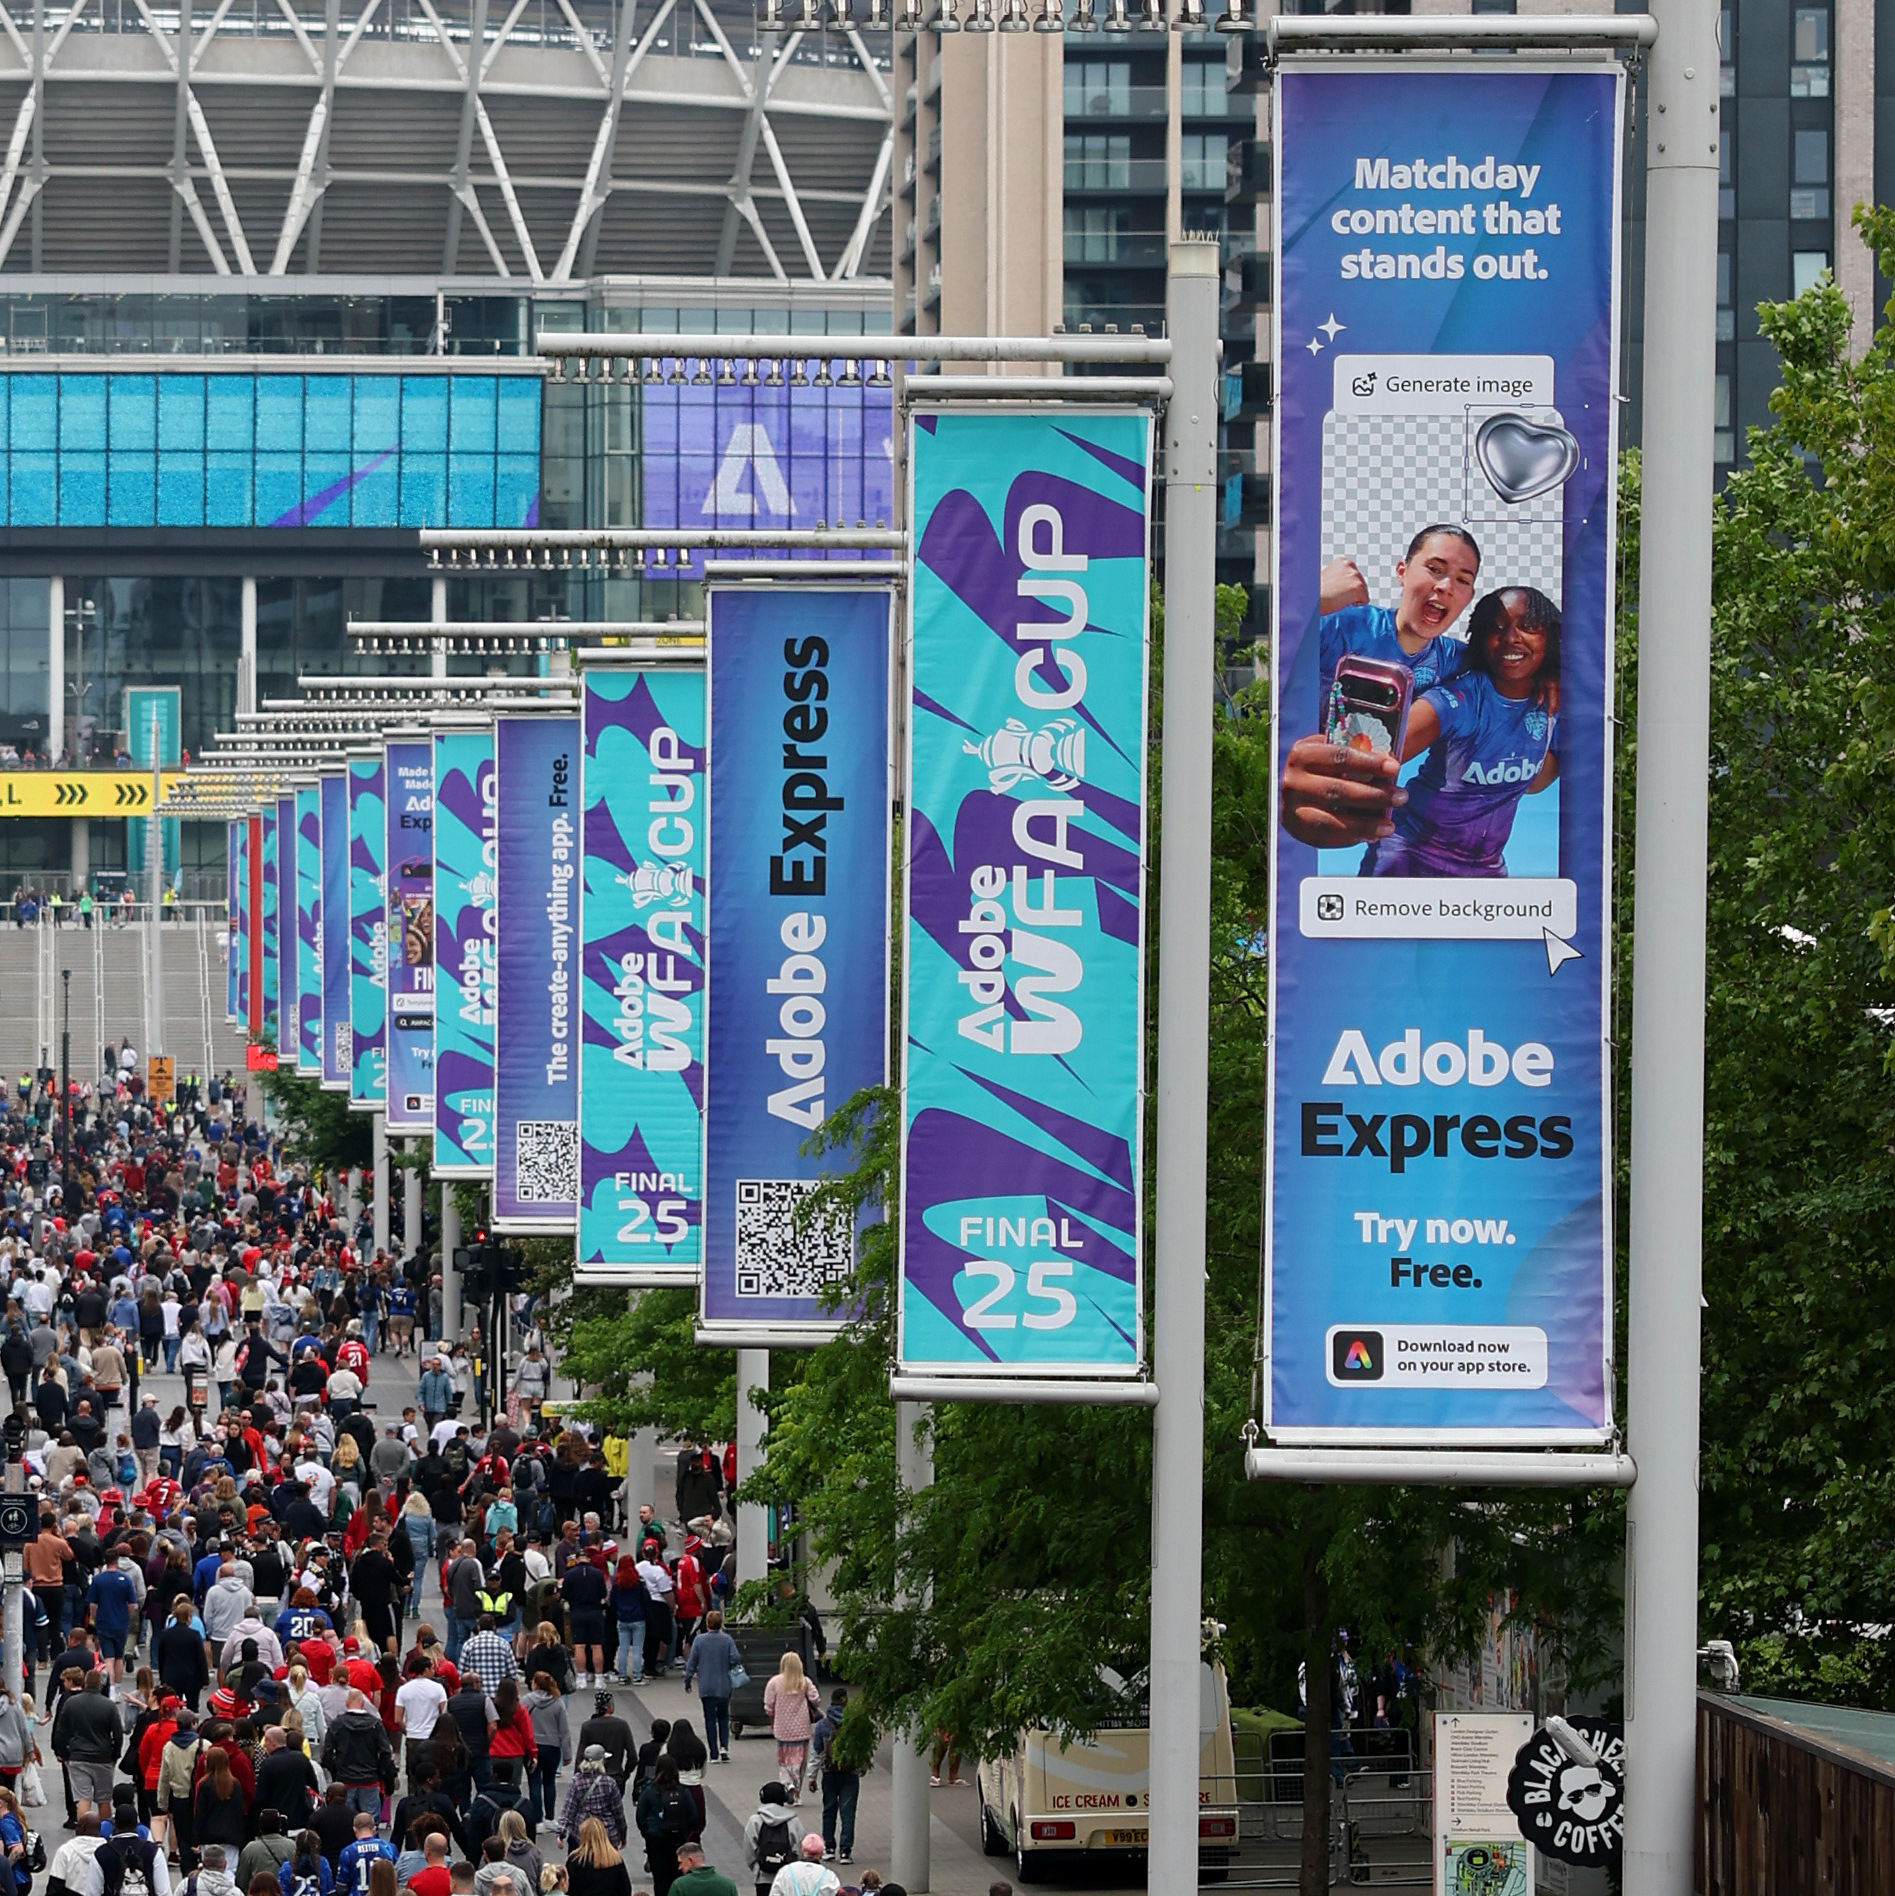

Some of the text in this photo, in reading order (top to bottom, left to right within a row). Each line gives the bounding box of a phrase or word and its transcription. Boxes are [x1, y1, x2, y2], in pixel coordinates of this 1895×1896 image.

[1354, 156, 1541, 198] Matchday
[1331, 202, 1562, 235] content that
[1340, 246, 1548, 280] stands out.
[1385, 376, 1533, 397] Generate image
[1014, 503, 1089, 710] CUP
[398, 767, 429, 777] Made
[648, 727, 694, 857] CUP
[766, 634, 845, 1131] Adobe Express
[547, 753, 575, 1085] The create-anything app. Free.
[1355, 900, 1553, 923] Remove background
[958, 864, 1006, 1053] Adobe
[459, 938, 481, 1025] Adobe
[613, 953, 645, 1071] Adobe
[411, 1046, 429, 1059] Try
[1321, 1028, 1555, 1087] Adobe
[1300, 1102, 1574, 1174] Express
[614, 1172, 693, 1193] FINAL
[616, 1200, 690, 1244] 25
[959, 1216, 1084, 1250] FINAL
[1353, 1211, 1516, 1251] Try now.
[1390, 1257, 1483, 1288] Free.
[962, 1262, 1079, 1331] 25
[348, 1351, 362, 1366] 21
[1397, 1339, 1510, 1354] Download now
[1397, 1359, 1532, 1376] on your app store.
[160, 1487, 169, 1504] 7
[290, 1616, 314, 1638] 20
[1052, 1794, 1120, 1809] ICE CREAM
[1554, 1804, 1624, 1854] COFFE
[357, 1845, 379, 1854] REITEN
